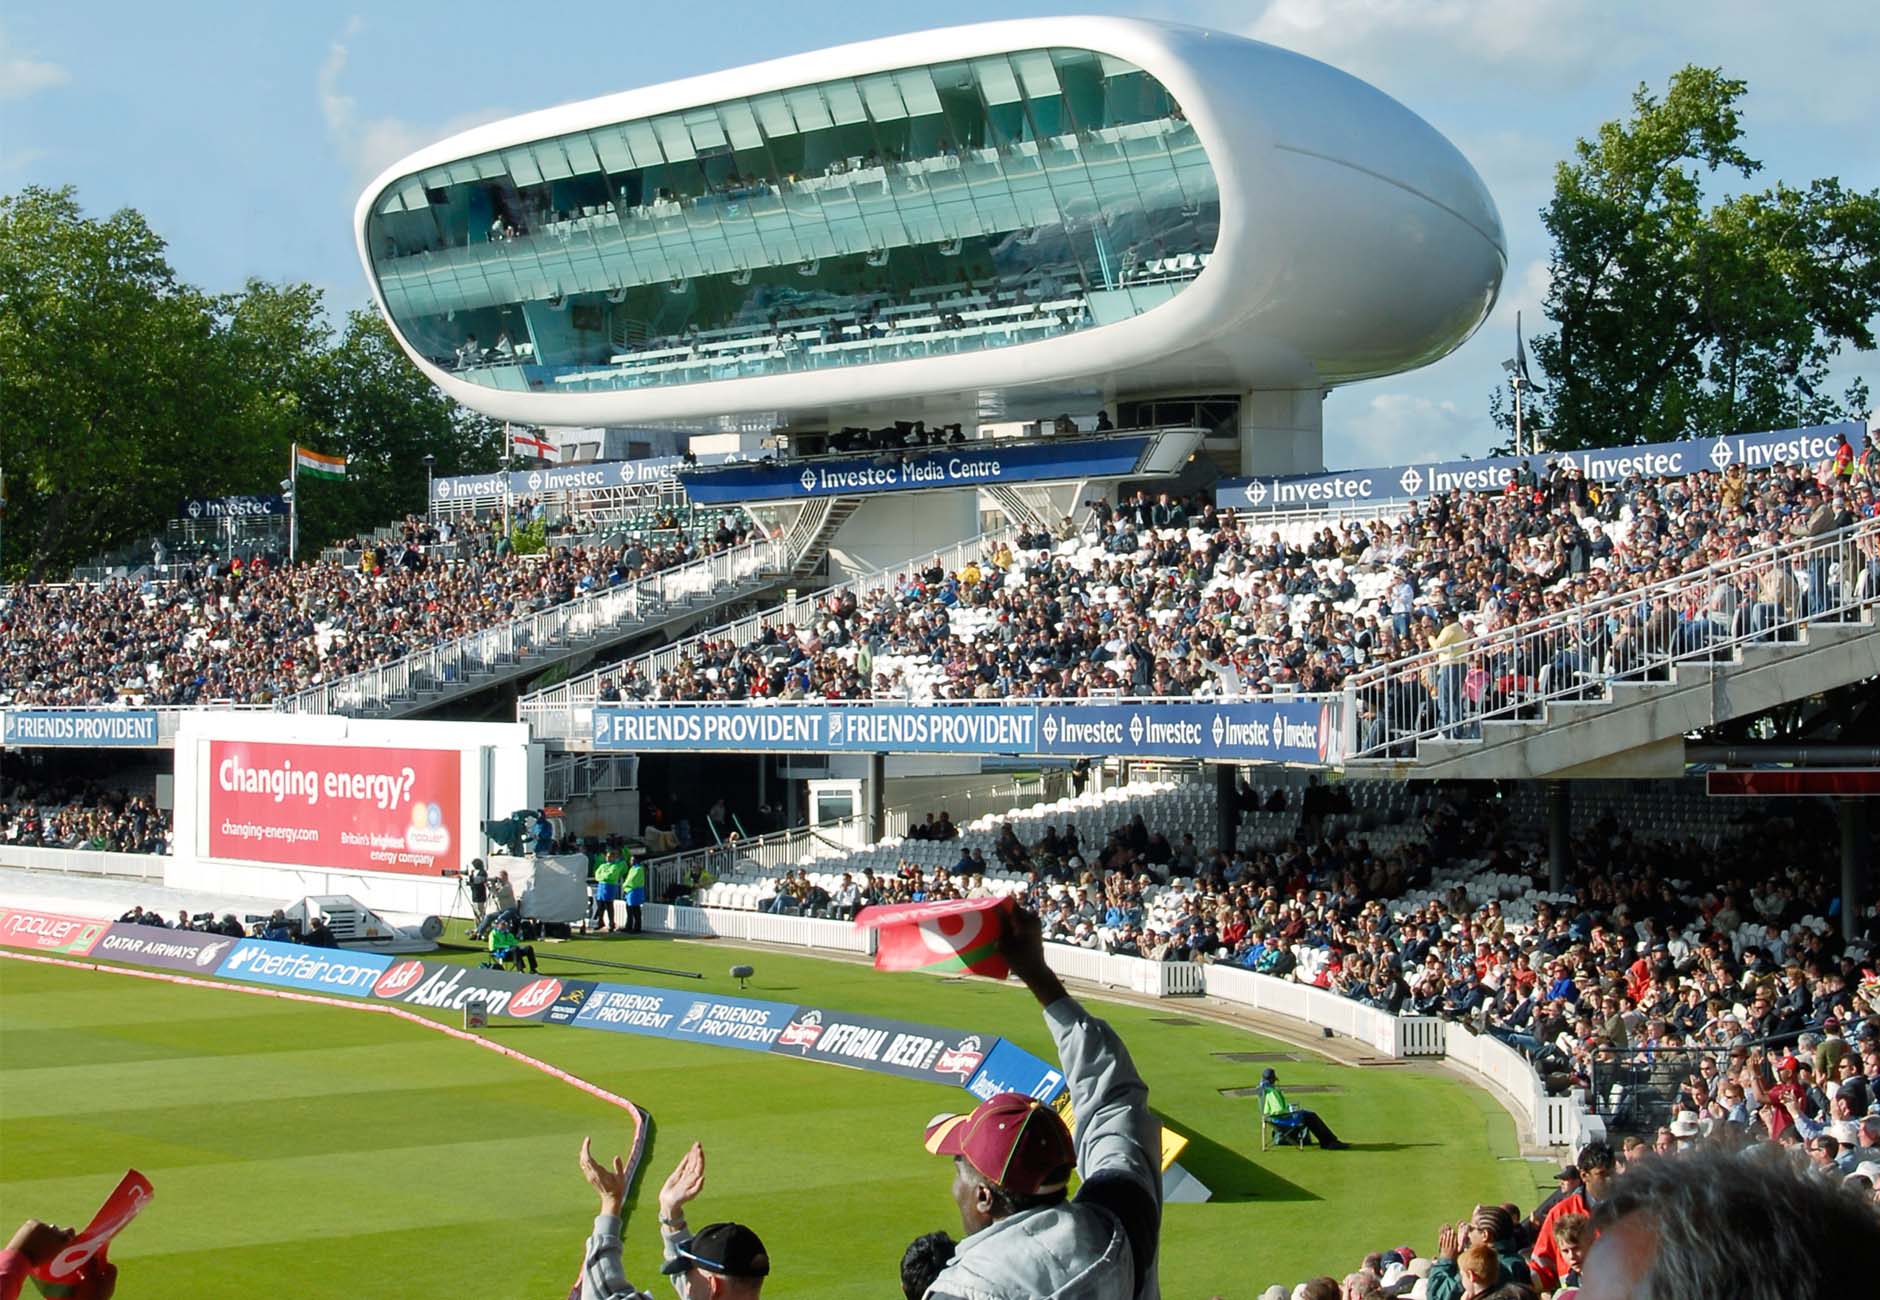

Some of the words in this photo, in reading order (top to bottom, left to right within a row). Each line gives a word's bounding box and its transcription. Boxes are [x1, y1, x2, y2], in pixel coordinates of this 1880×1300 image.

[1739, 435, 1837, 466] Investec
[545, 469, 604, 488] Investec
[821, 465, 897, 488] Investec
[902, 462, 945, 483] Media
[950, 459, 1001, 481] Centre
[1584, 451, 1682, 479] Investec
[1273, 478, 1372, 502] Investec
[1429, 466, 1512, 493] Investe
[206, 500, 271, 516] Investec
[17, 717, 73, 738] FRIENDS
[75, 718, 153, 740] PROVIDENT
[614, 715, 700, 742] FRIENDS
[704, 714, 822, 743] PROVIDENT
[847, 715, 927, 744] FRIENDS
[930, 715, 1033, 745] PROVIDENT
[1060, 716, 1123, 744] Investec
[1146, 717, 1202, 745] Investec
[1225, 716, 1269, 747] Investec
[1283, 716, 1317, 749] Investec
[219, 755, 319, 805] Changing
[324, 767, 416, 810] energy?
[221, 818, 319, 843] changing-energy.com
[341, 831, 369, 846] Britain's
[370, 850, 398, 864] energy
[398, 852, 435, 868] company
[4, 914, 81, 937] npower
[102, 935, 145, 953] QATAR
[143, 941, 199, 959] AIRWAYS
[250, 948, 383, 988] betfair.com
[382, 961, 421, 989] Ask
[404, 965, 512, 1015] Ask.com
[512, 979, 557, 1008] Ask
[605, 992, 663, 1011] FRIENDS
[596, 1007, 674, 1029] PROVIDENT
[708, 1004, 770, 1024] FRIENDS
[698, 1020, 782, 1044] PROVIDENT
[816, 1023, 883, 1060] OFFICIAL
[881, 1034, 933, 1069] BEER
